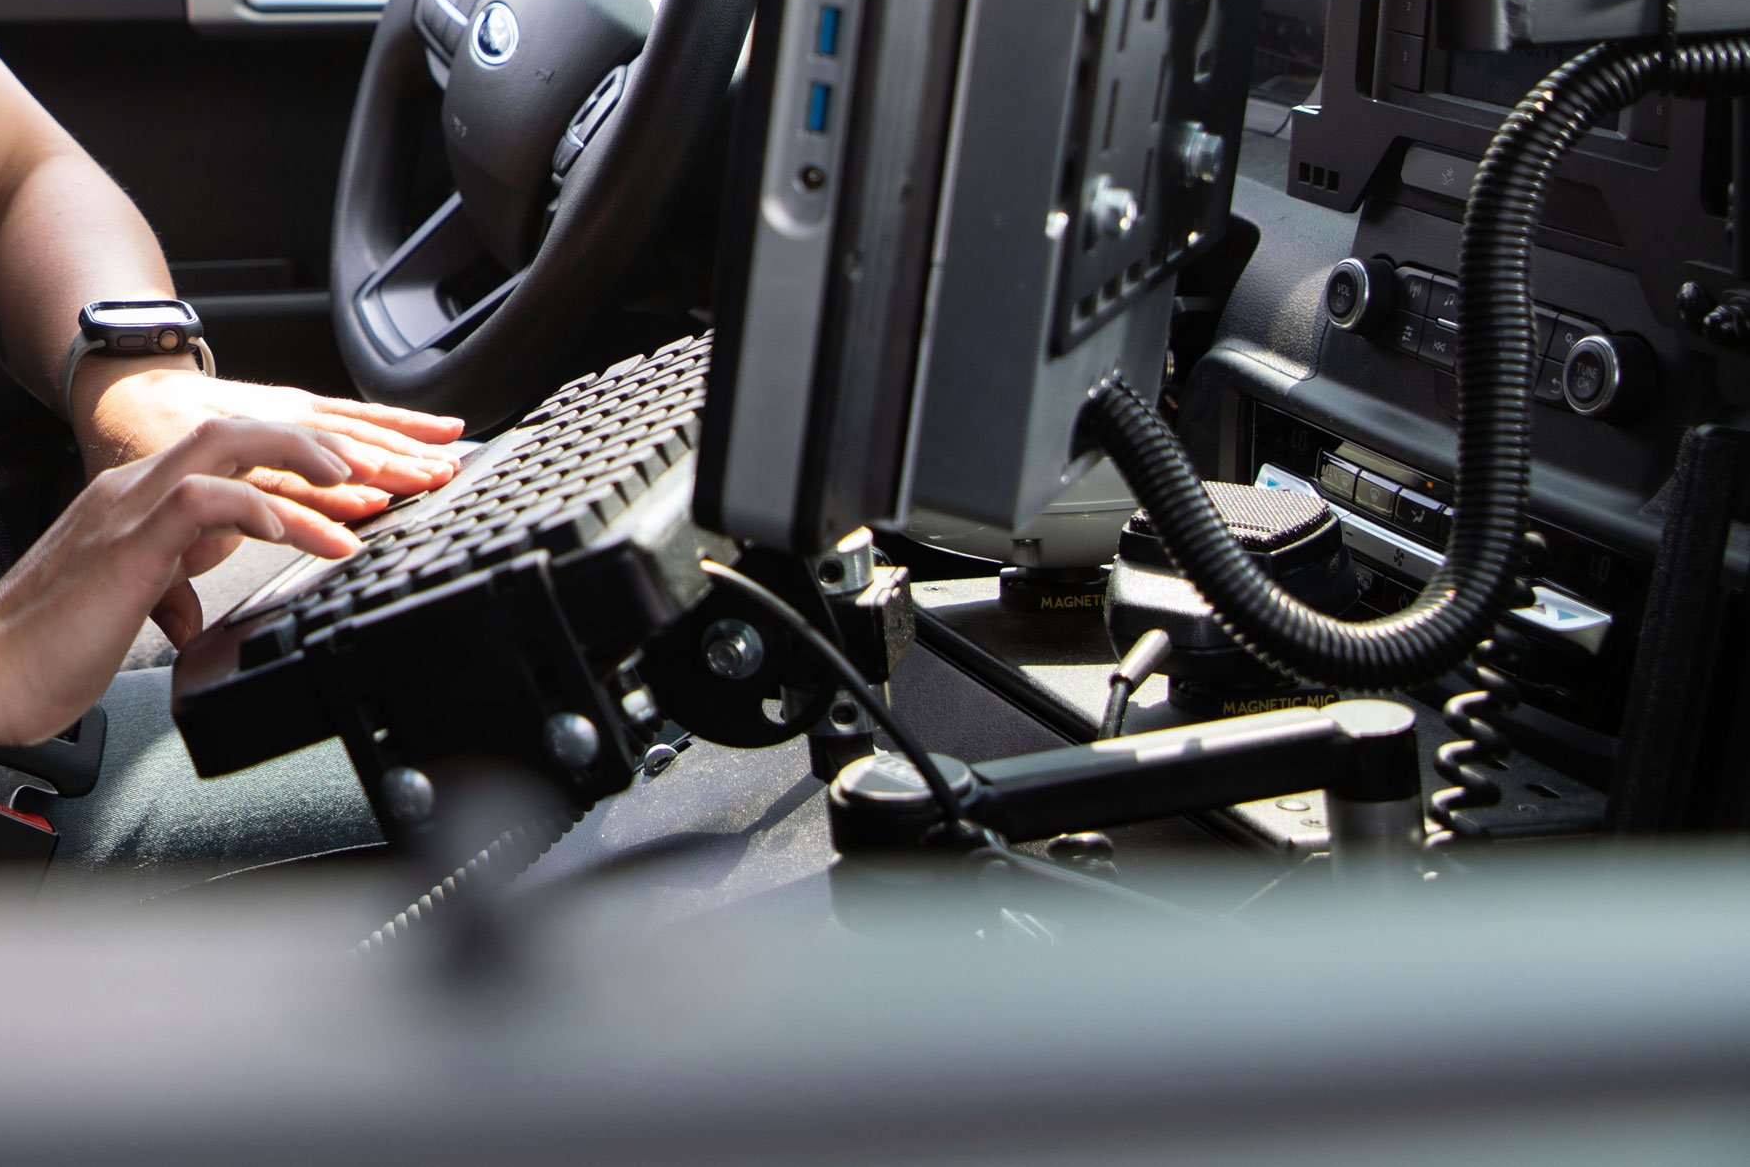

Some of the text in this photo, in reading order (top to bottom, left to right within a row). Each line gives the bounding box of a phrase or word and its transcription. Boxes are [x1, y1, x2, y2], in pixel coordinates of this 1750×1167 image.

[1337, 282, 1350, 297] VOL
[1576, 362, 1598, 380] TUNE
[1577, 376, 1591, 390] OK
[1040, 594, 1106, 609] MAGNETI
[1223, 694, 1335, 715] MAGNETIC MIC
